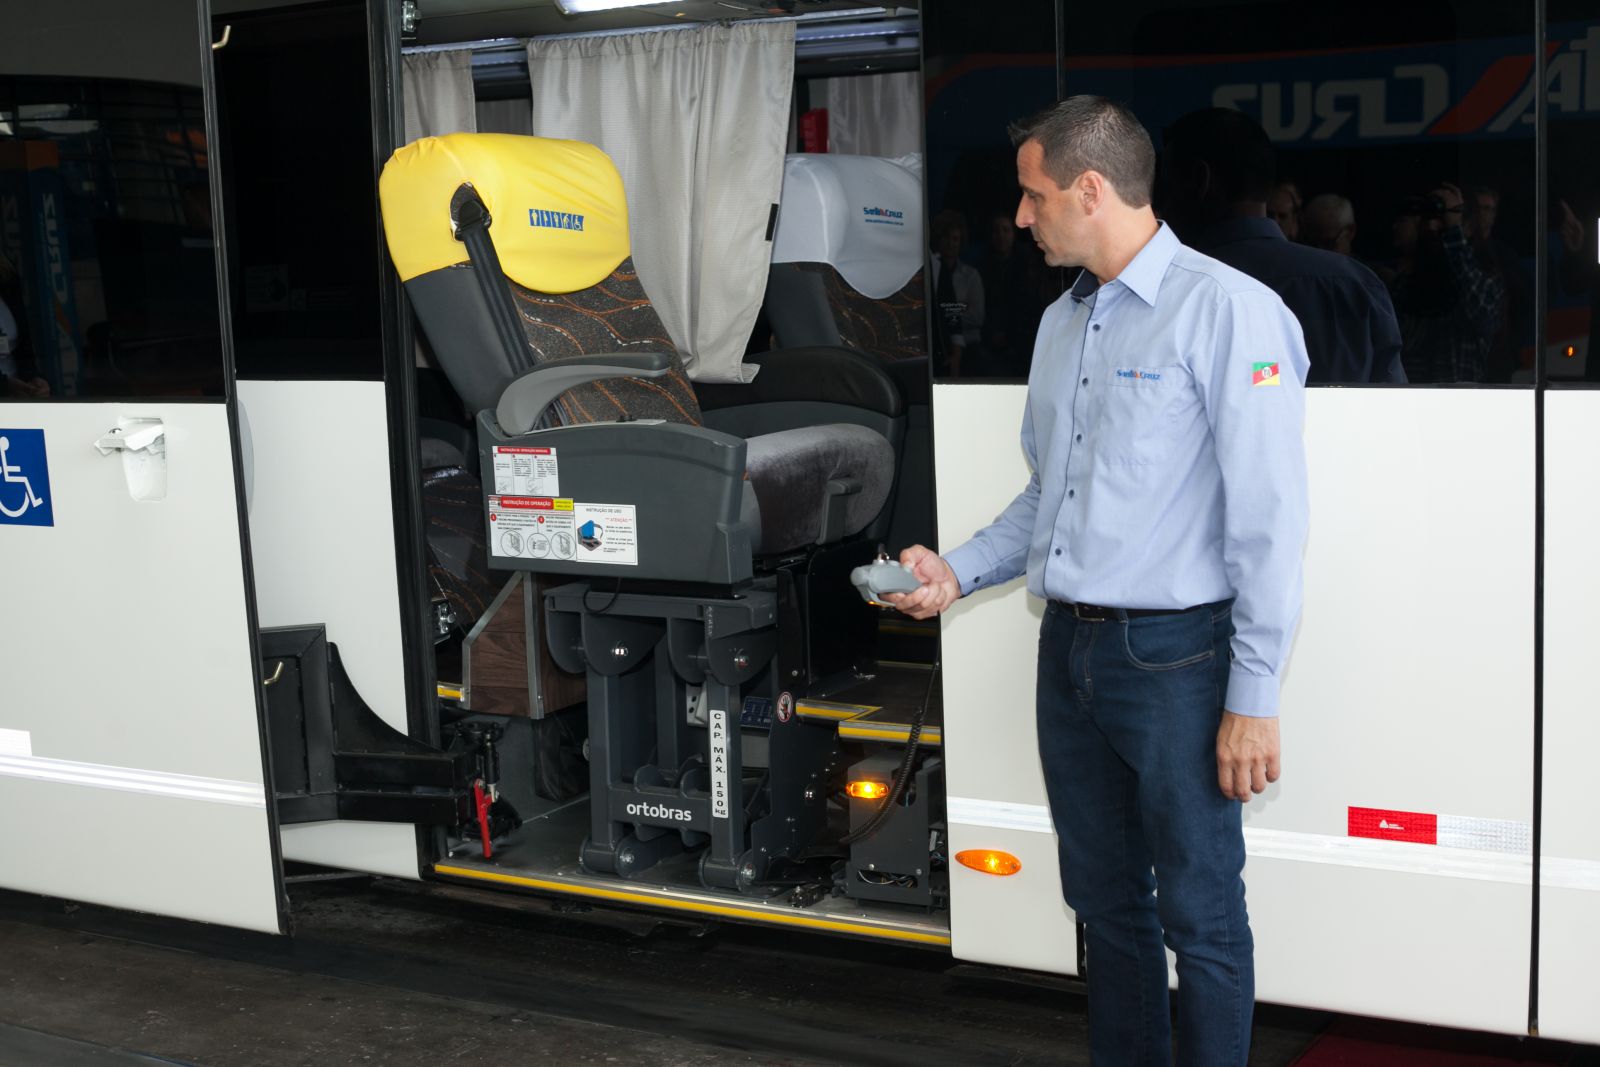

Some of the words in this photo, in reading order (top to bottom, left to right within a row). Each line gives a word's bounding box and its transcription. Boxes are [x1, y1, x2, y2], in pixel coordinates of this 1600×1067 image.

[713, 712, 723, 740] CAP.
[713, 746, 726, 774] MÁX.
[715, 781, 724, 807] 150
[626, 802, 692, 822] ortobras
[715, 808, 727, 816] kg
